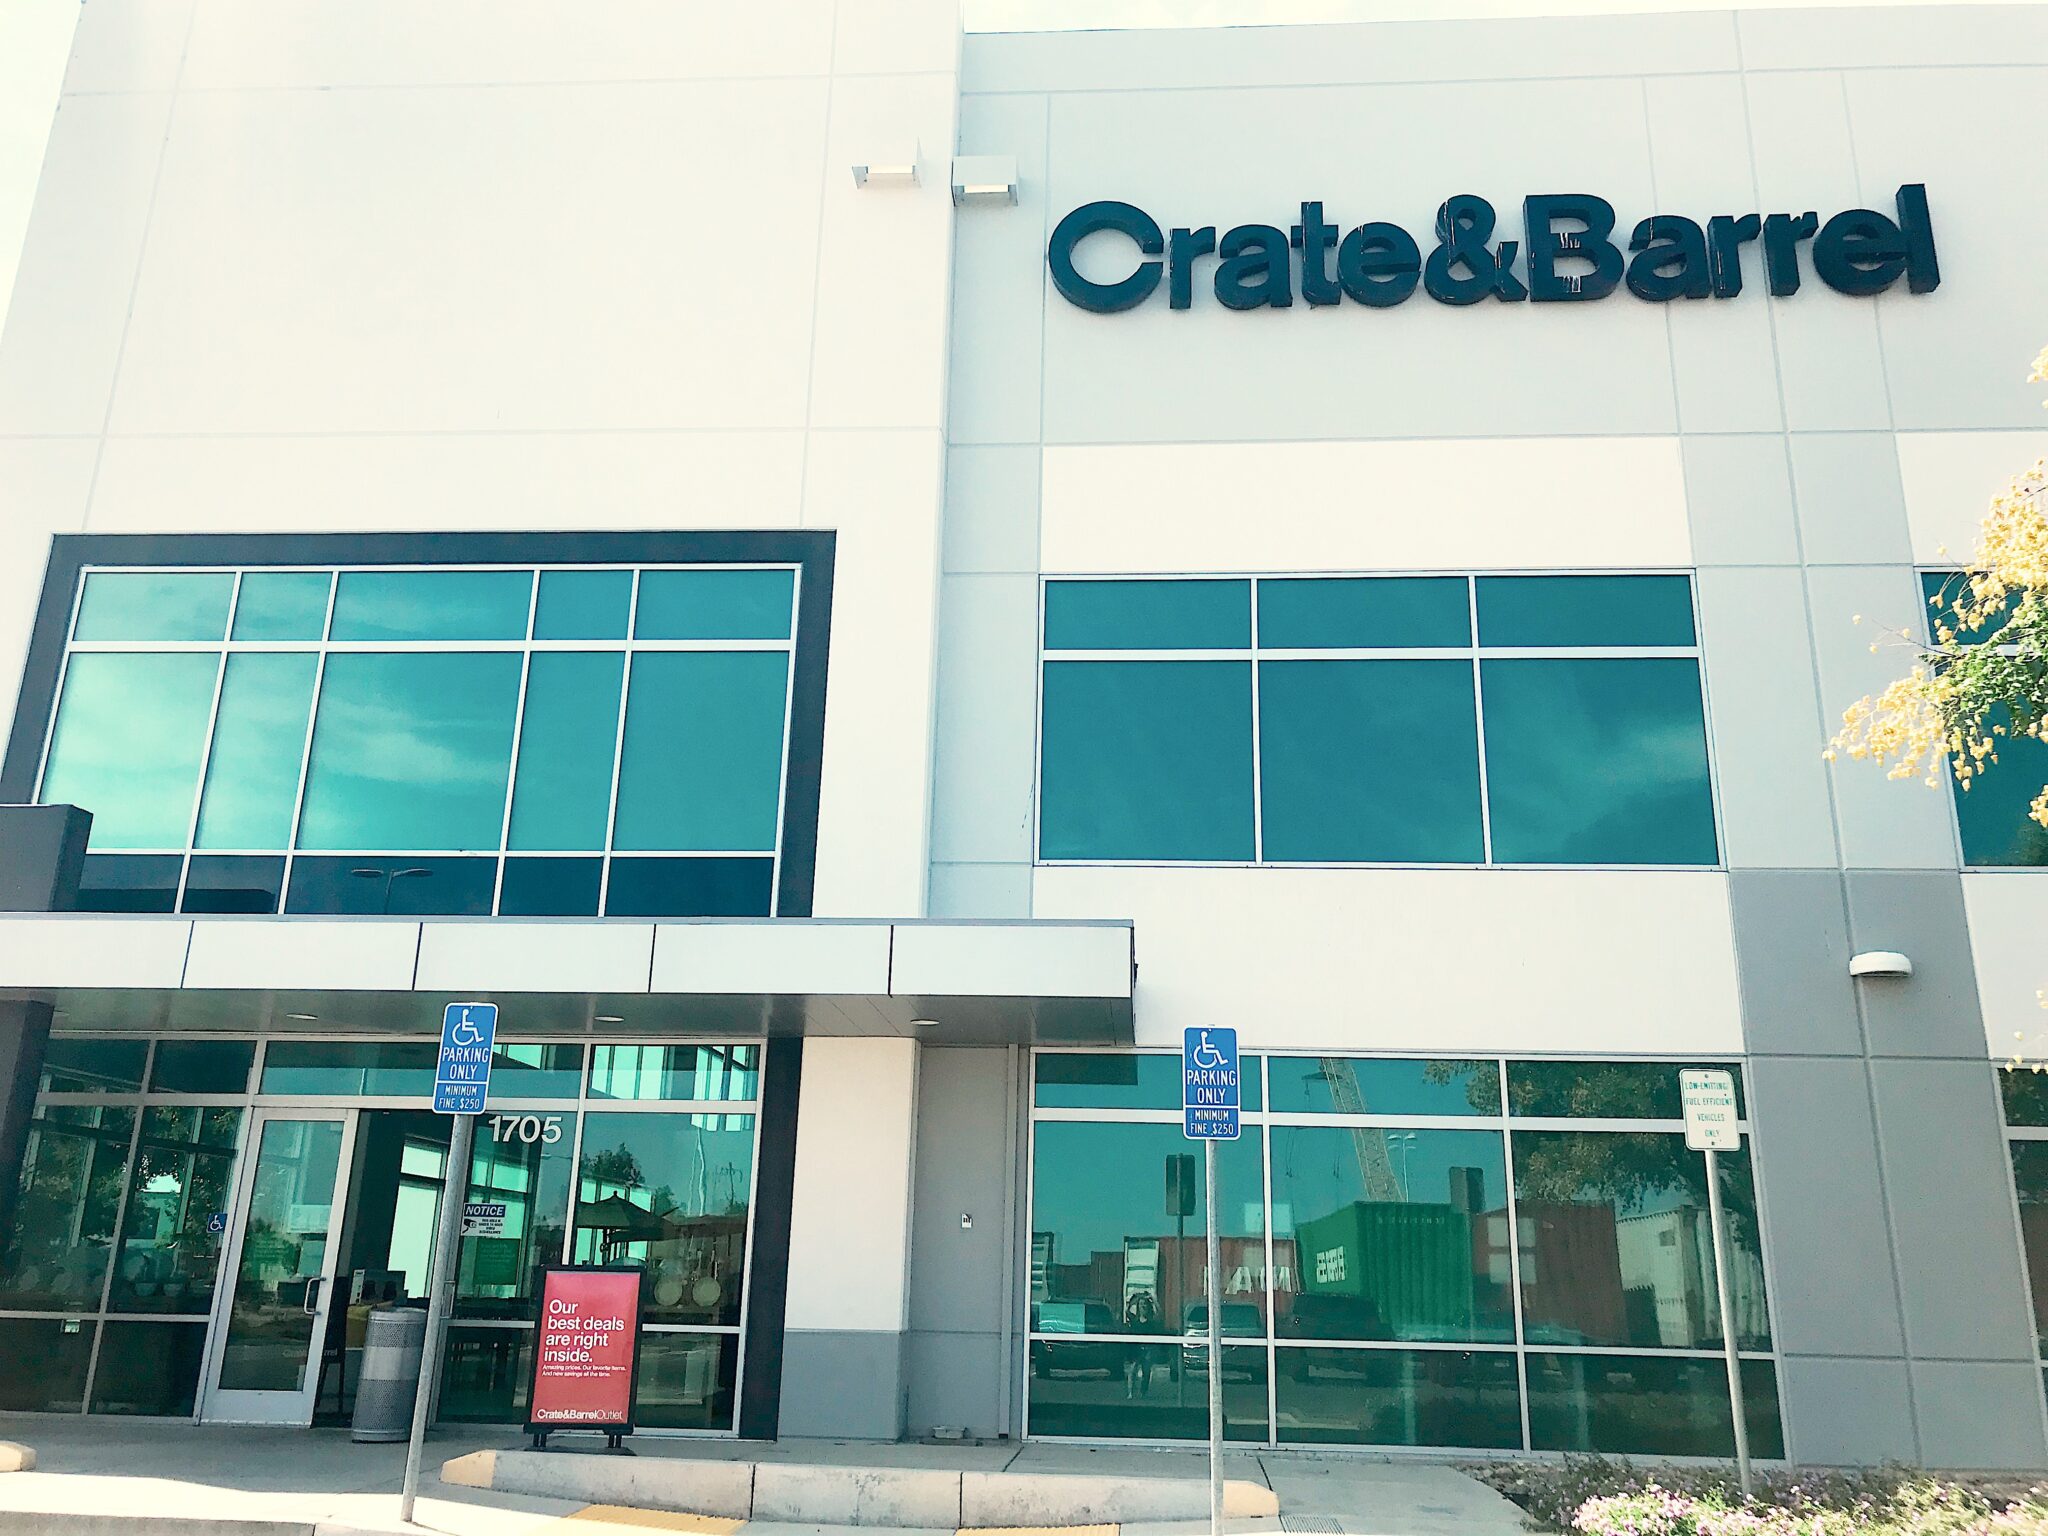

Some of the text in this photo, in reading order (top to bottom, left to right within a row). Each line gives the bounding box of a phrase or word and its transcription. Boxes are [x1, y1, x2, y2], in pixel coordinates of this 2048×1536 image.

[1048, 184, 1941, 313] Crate&Barrel
[442, 1047, 490, 1063] PARKING
[449, 1064, 478, 1080] ONLY
[1186, 1069, 1237, 1086] PARKING
[444, 1085, 478, 1096] MINIMUM
[1197, 1087, 1226, 1104] ONLY
[439, 1097, 480, 1110] FINE $250
[1685, 1097, 1733, 1106] FUEL EFFICIENT
[1194, 1109, 1229, 1121] MINIMUM
[1696, 1113, 1725, 1122] VEHICLES
[488, 1115, 562, 1144] 1705
[1190, 1122, 1234, 1135] FINE $250
[1704, 1129, 1720, 1138] ONLY
[465, 1205, 504, 1216] NOTICE
[549, 1299, 579, 1314] Our
[547, 1315, 625, 1331] best deals
[545, 1332, 609, 1350] are right
[544, 1347, 593, 1363] inside.
